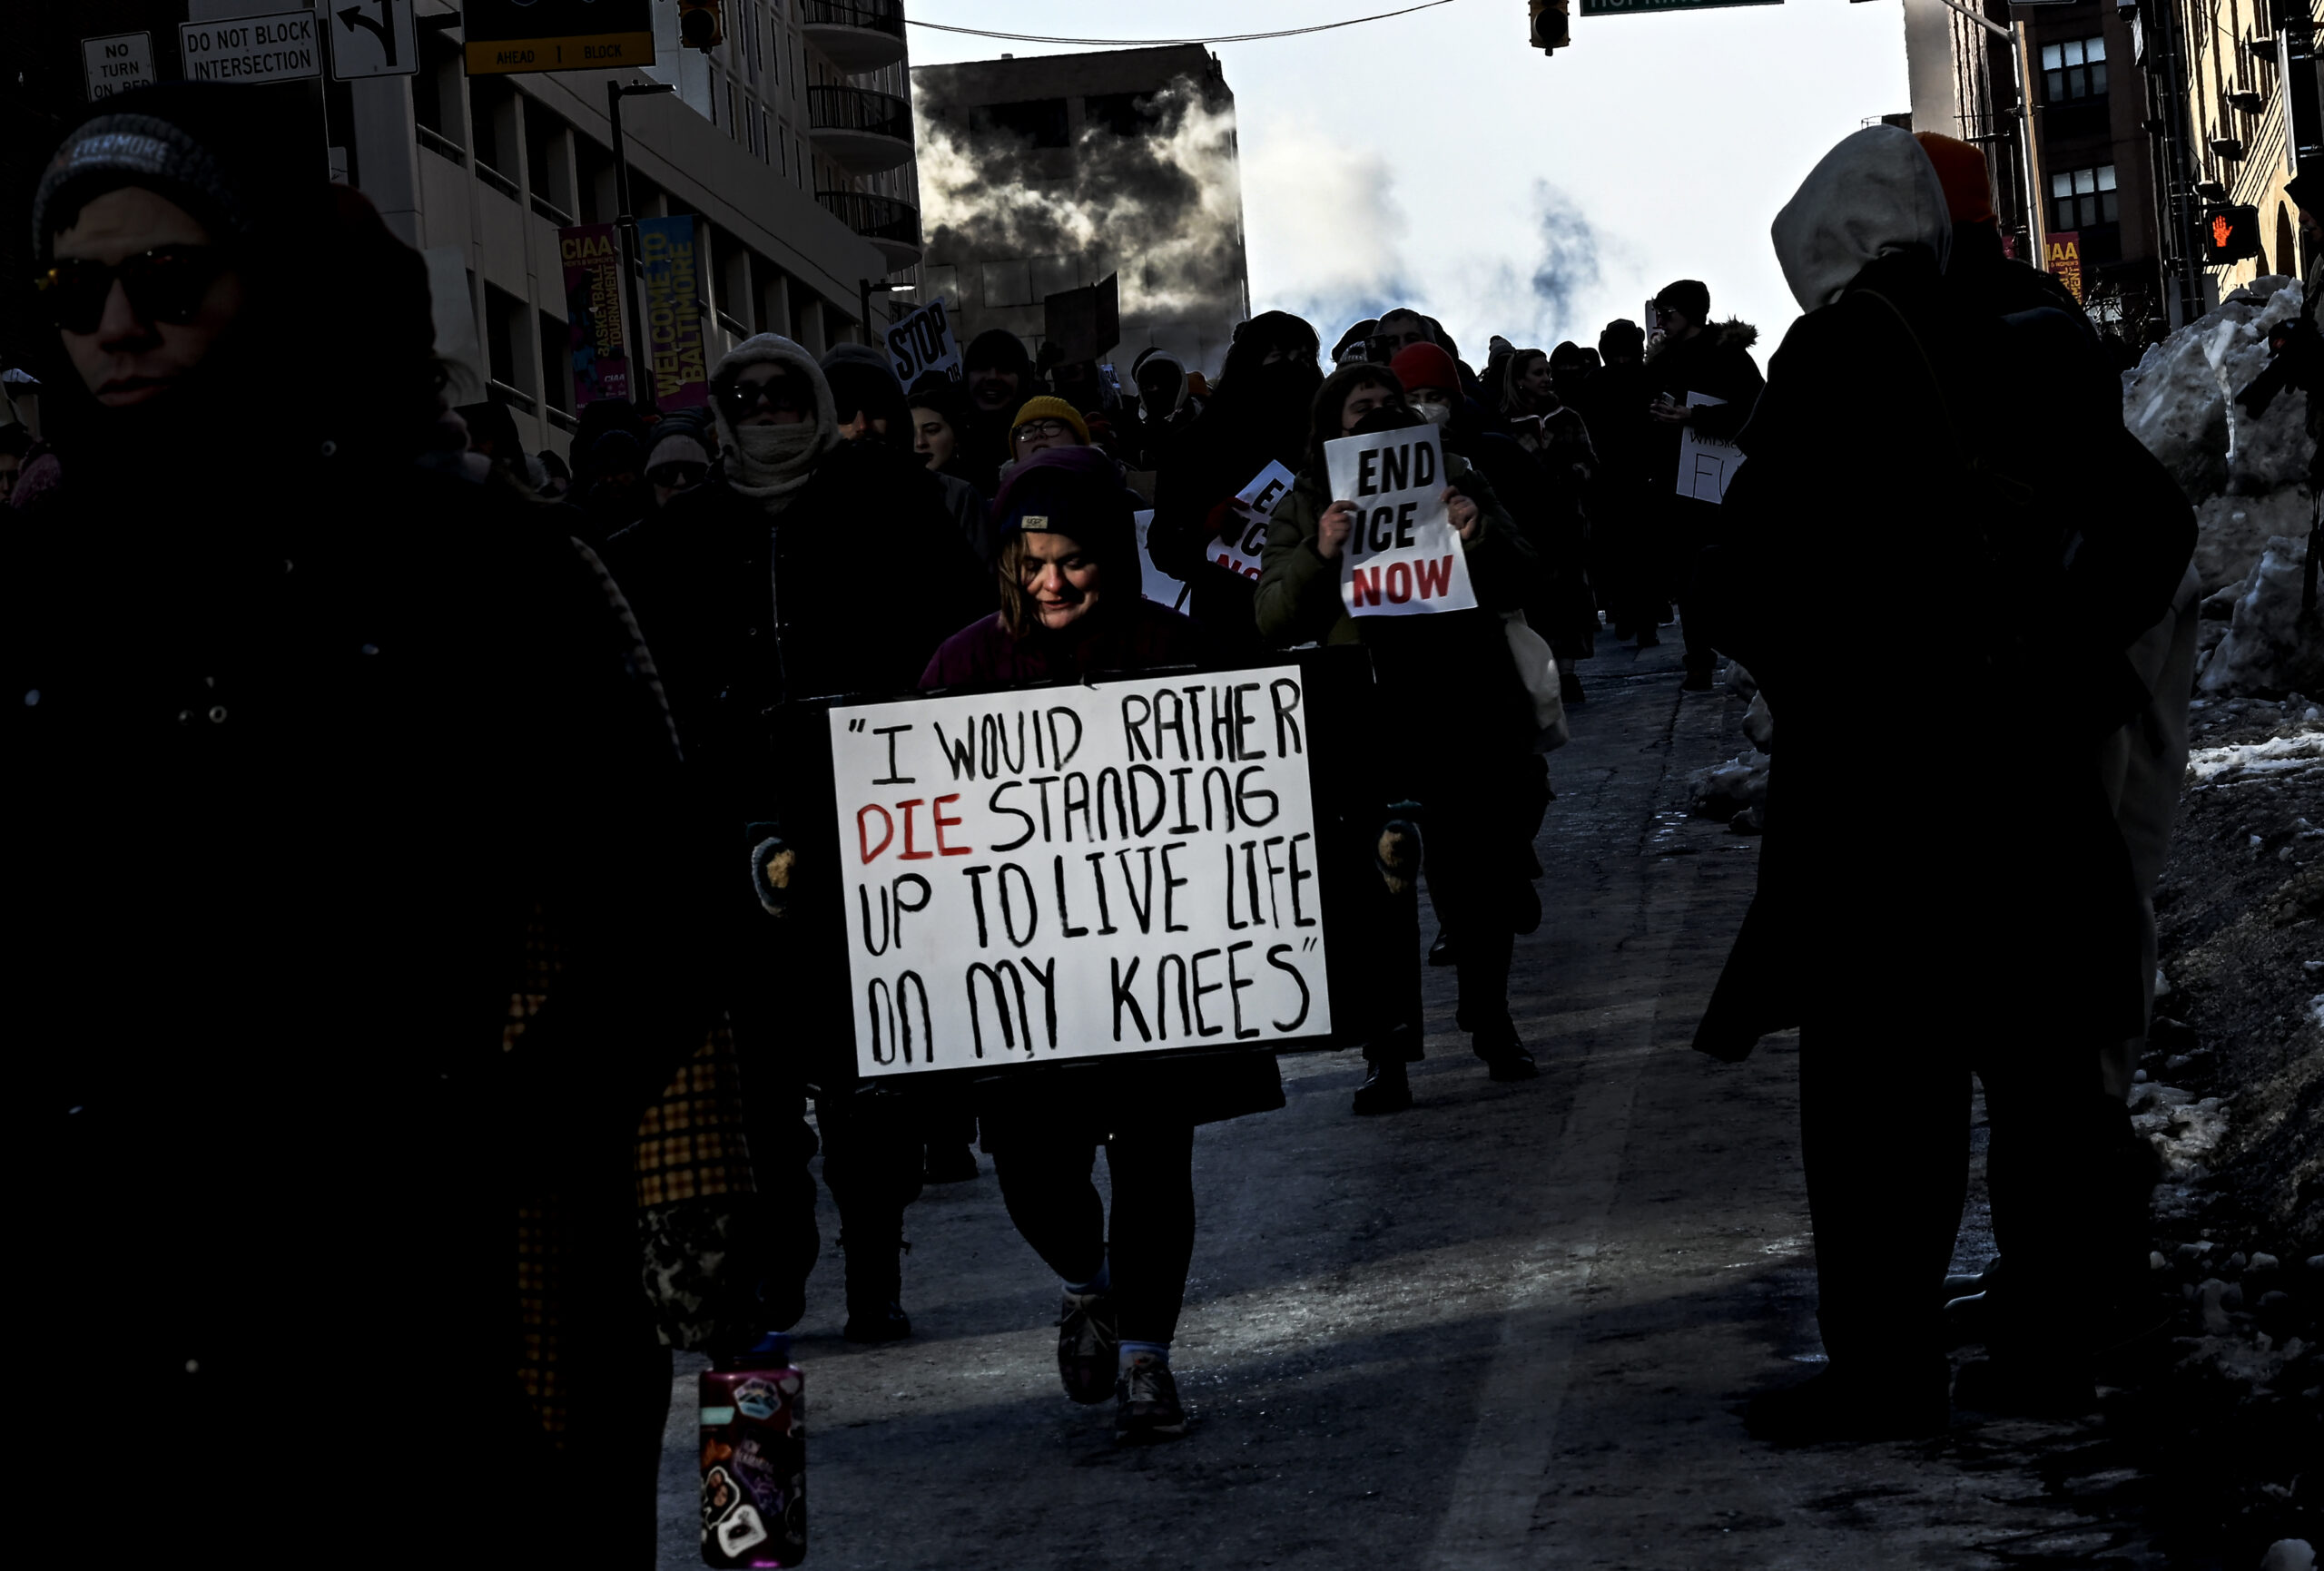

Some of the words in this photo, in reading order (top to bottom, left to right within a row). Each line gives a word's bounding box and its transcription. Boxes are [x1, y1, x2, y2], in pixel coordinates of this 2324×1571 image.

[105, 44, 129, 58] NO
[188, 33, 210, 53] DO
[217, 28, 249, 49] NOT
[255, 20, 310, 44] BLOCK
[497, 51, 535, 65] AHEAD
[585, 44, 623, 59] BLOCK
[94, 83, 113, 98] ON
[101, 62, 139, 77] TURN
[194, 49, 311, 81] INTERSECTION
[561, 234, 614, 260] CIAA
[644, 232, 667, 270] TO
[2045, 241, 2078, 261] IAA
[603, 263, 624, 348] TOURNAMENT
[669, 241, 705, 383] BALTIMORE
[646, 273, 681, 398] WELCOME
[888, 302, 947, 381] STOP
[1358, 441, 1434, 496] END
[1353, 502, 1417, 555] ICE
[1353, 555, 1453, 607] NOW
[1121, 678, 1303, 761] RATHER
[857, 794, 972, 864] DIE
[989, 764, 1279, 851] STANDING
[860, 872, 931, 956] UP
[962, 863, 1038, 948] TO
[1054, 842, 1189, 938] LIVE
[1226, 832, 1316, 929] LIFE
[868, 970, 933, 1065] ON
[966, 957, 1057, 1059] MY
